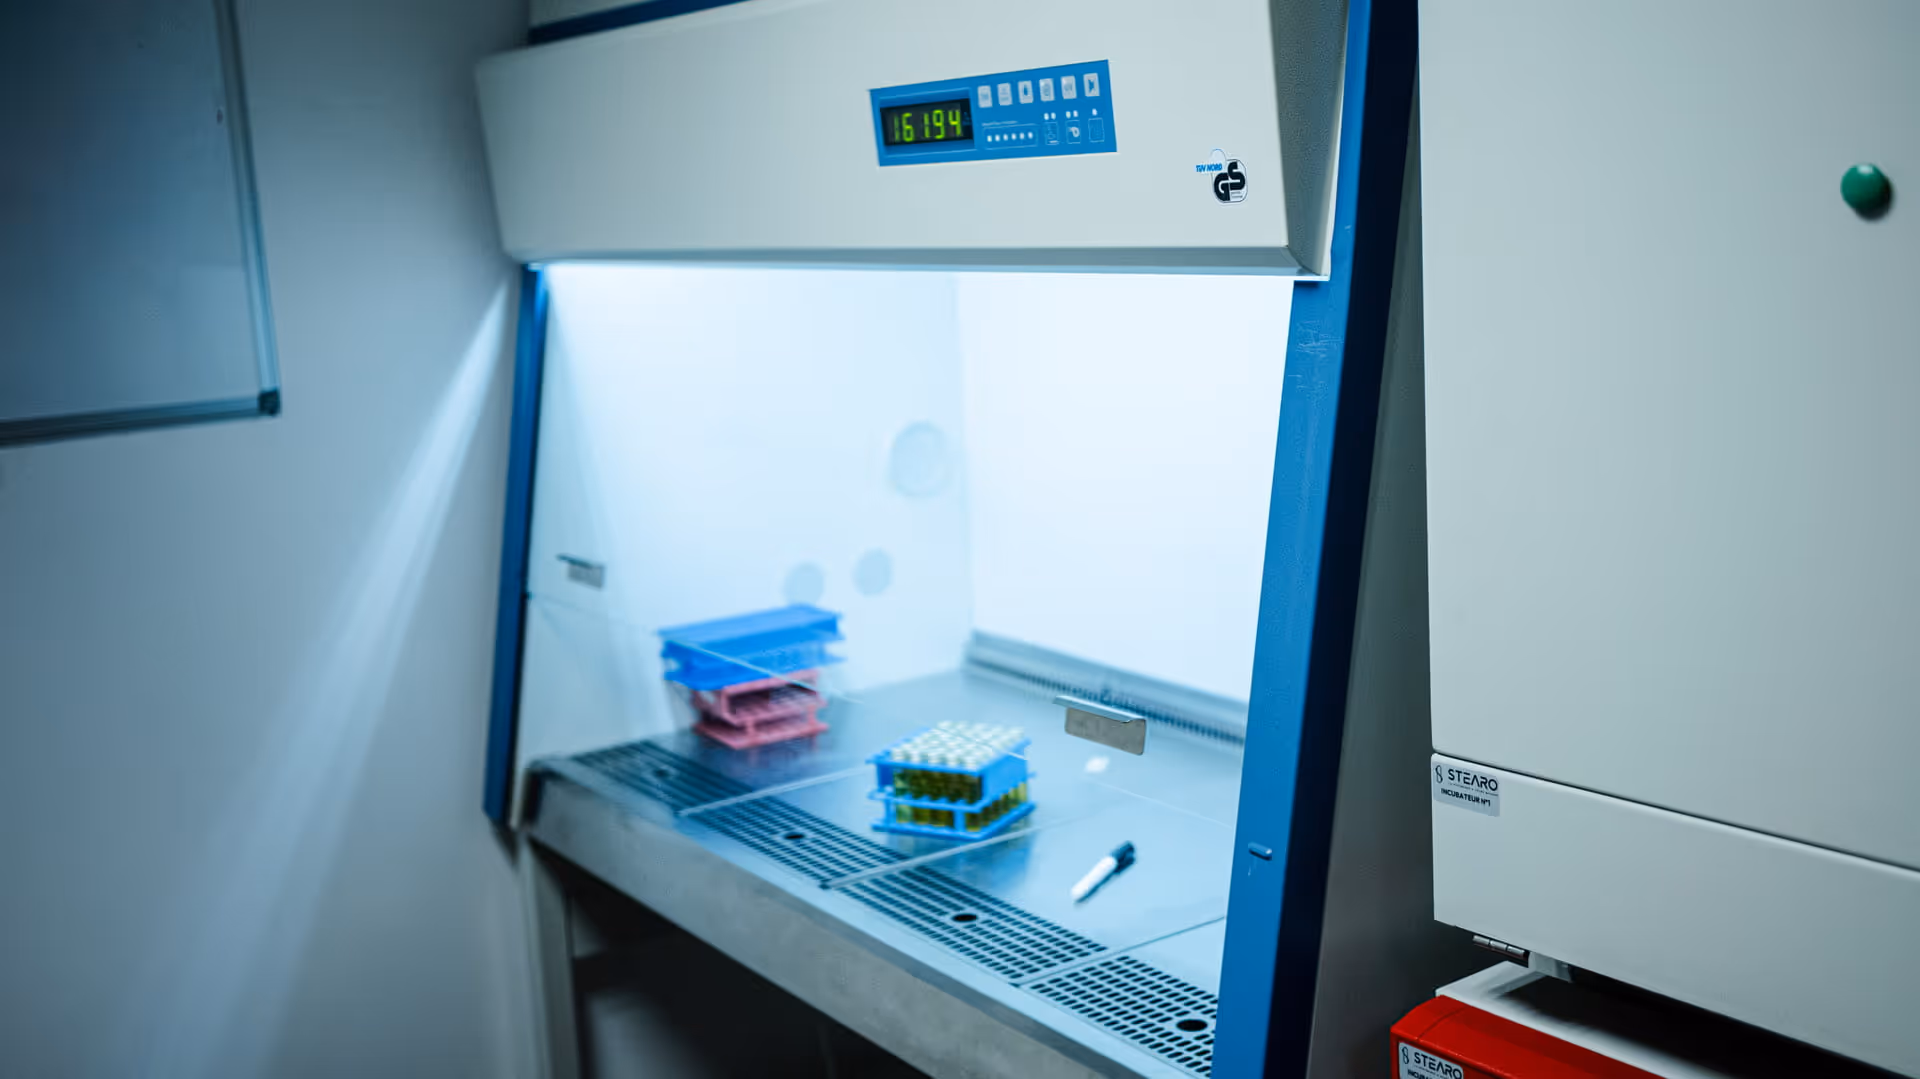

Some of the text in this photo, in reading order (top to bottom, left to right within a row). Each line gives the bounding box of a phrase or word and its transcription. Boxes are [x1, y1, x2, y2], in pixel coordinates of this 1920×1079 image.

[1213, 161, 1246, 201] GS
[1448, 768, 1498, 791] STEARO
[1441, 787, 1480, 803] INCUBATEUR
[1414, 1051, 1463, 1079] STEARO
